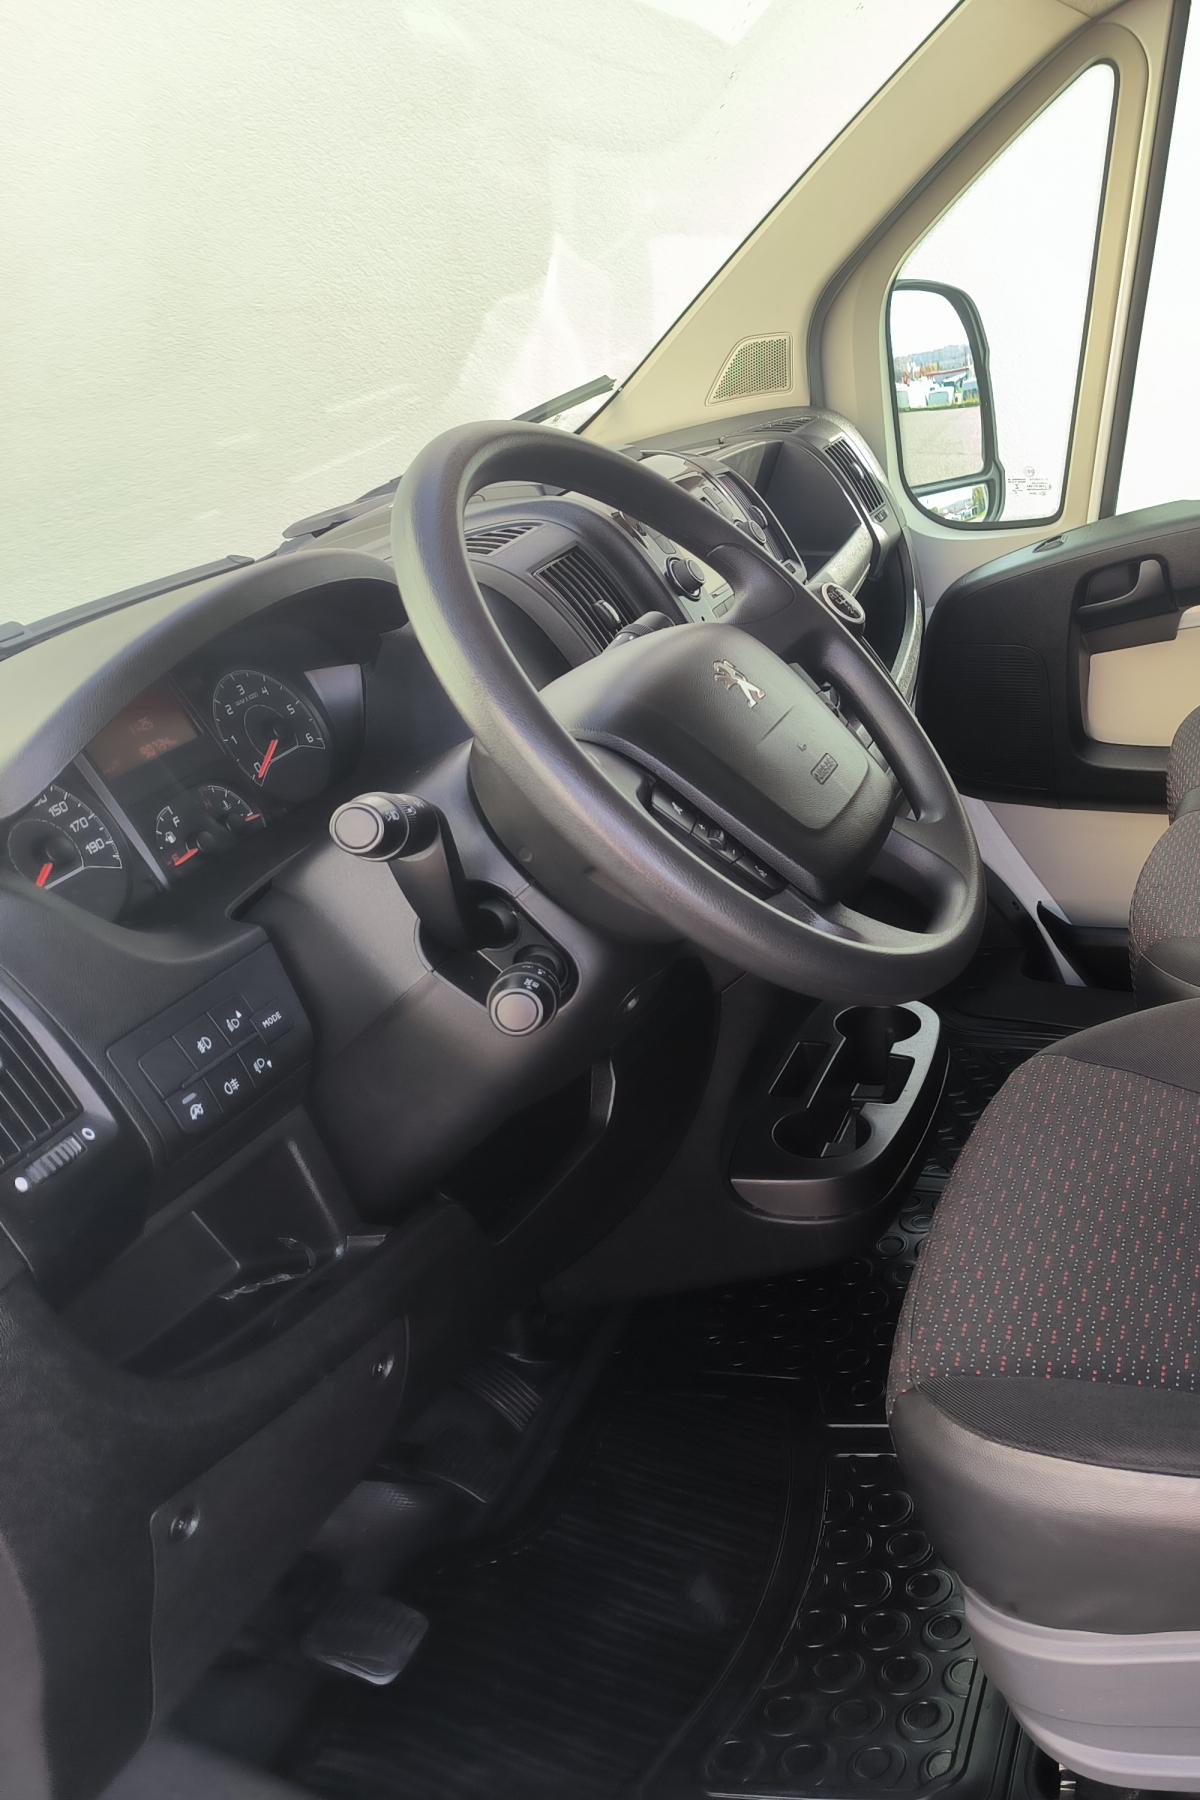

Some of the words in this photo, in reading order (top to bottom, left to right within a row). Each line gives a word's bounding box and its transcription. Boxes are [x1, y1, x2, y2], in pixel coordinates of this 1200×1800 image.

[236, 684, 245, 696] 3
[261, 686, 270, 696] 4
[224, 704, 234, 715] 2
[286, 704, 296, 715] 5
[230, 735, 238, 745] 1
[305, 733, 314, 743] 6
[48, 800, 69, 817] 150
[69, 817, 89, 833] 170
[172, 815, 181, 828] F
[85, 838, 105, 855] 190
[262, 1010, 282, 1028] MODE
